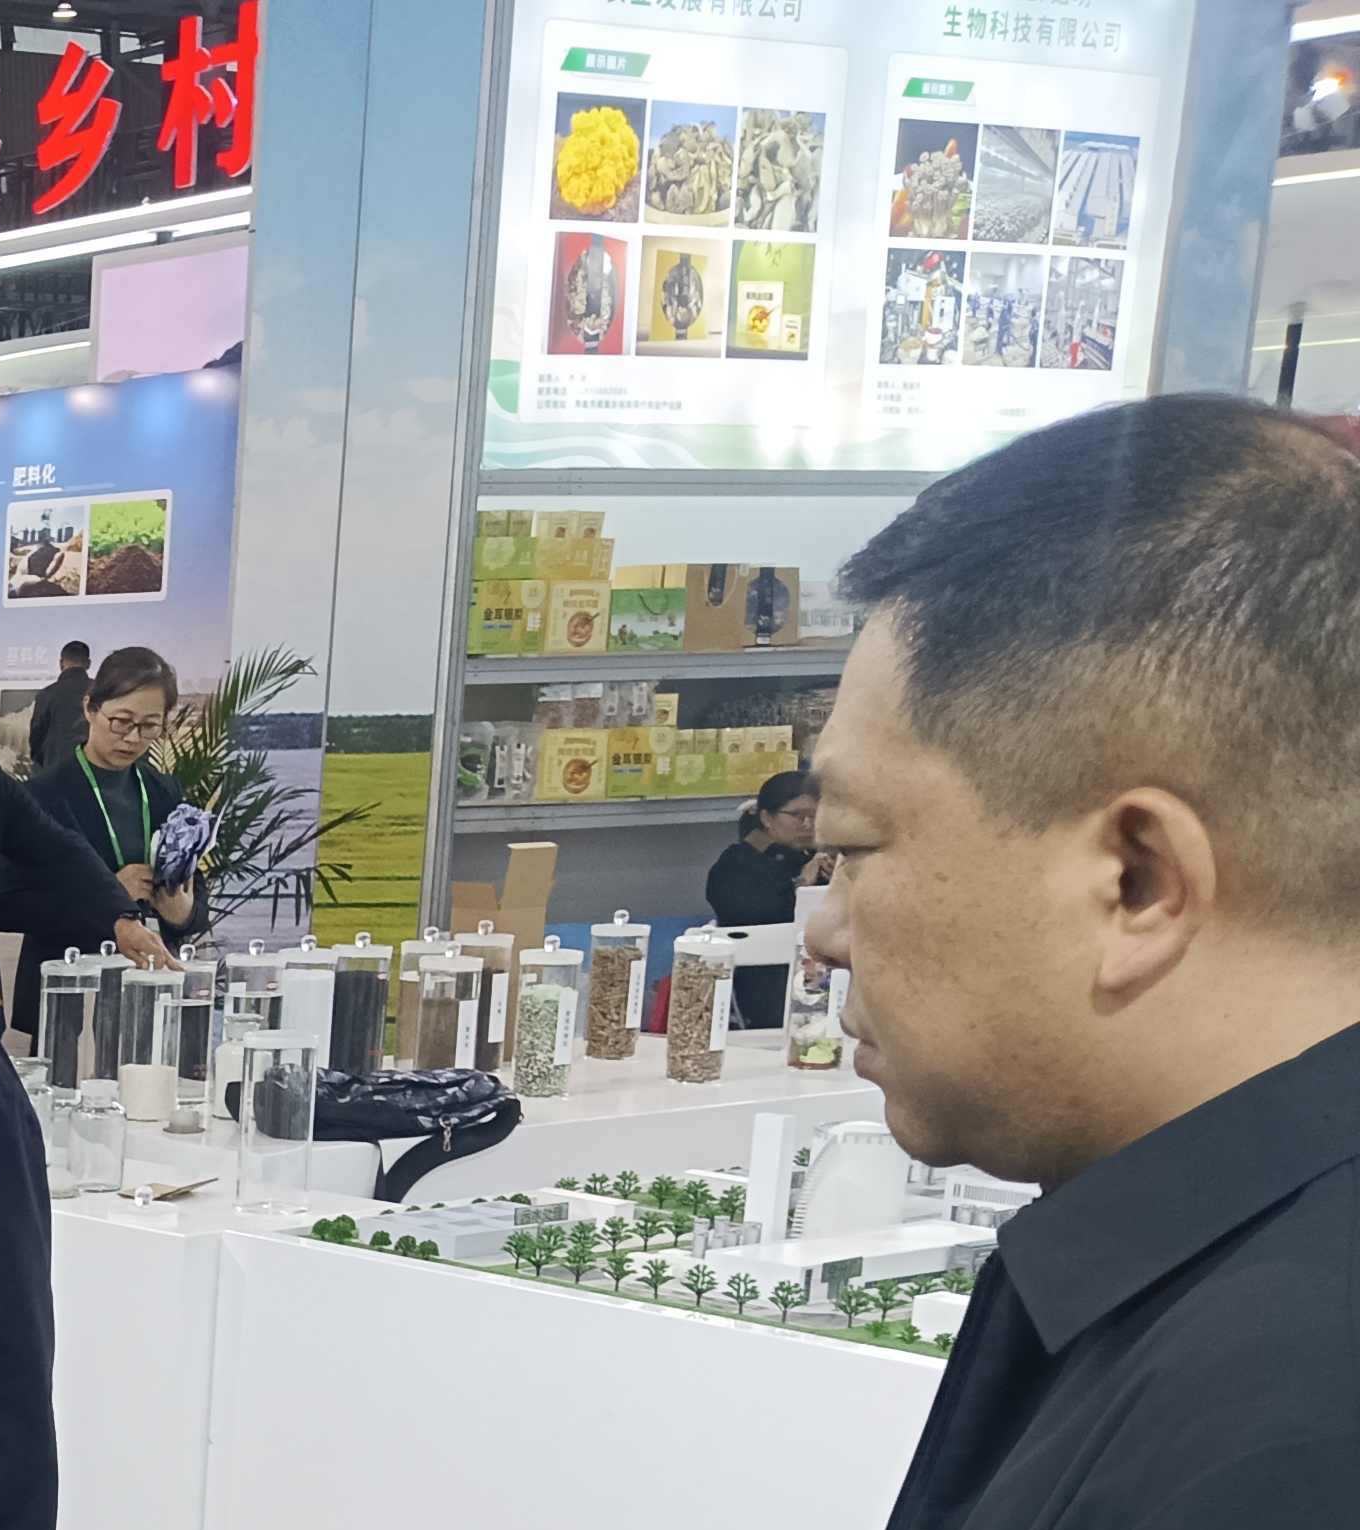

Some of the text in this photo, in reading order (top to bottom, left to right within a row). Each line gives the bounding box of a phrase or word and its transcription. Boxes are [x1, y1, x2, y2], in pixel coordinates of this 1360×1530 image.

[943, 4, 1123, 53] 生物科技有限公司
[13, 463, 56, 487] 肥料化
[6, 645, 49, 667] 基料化
